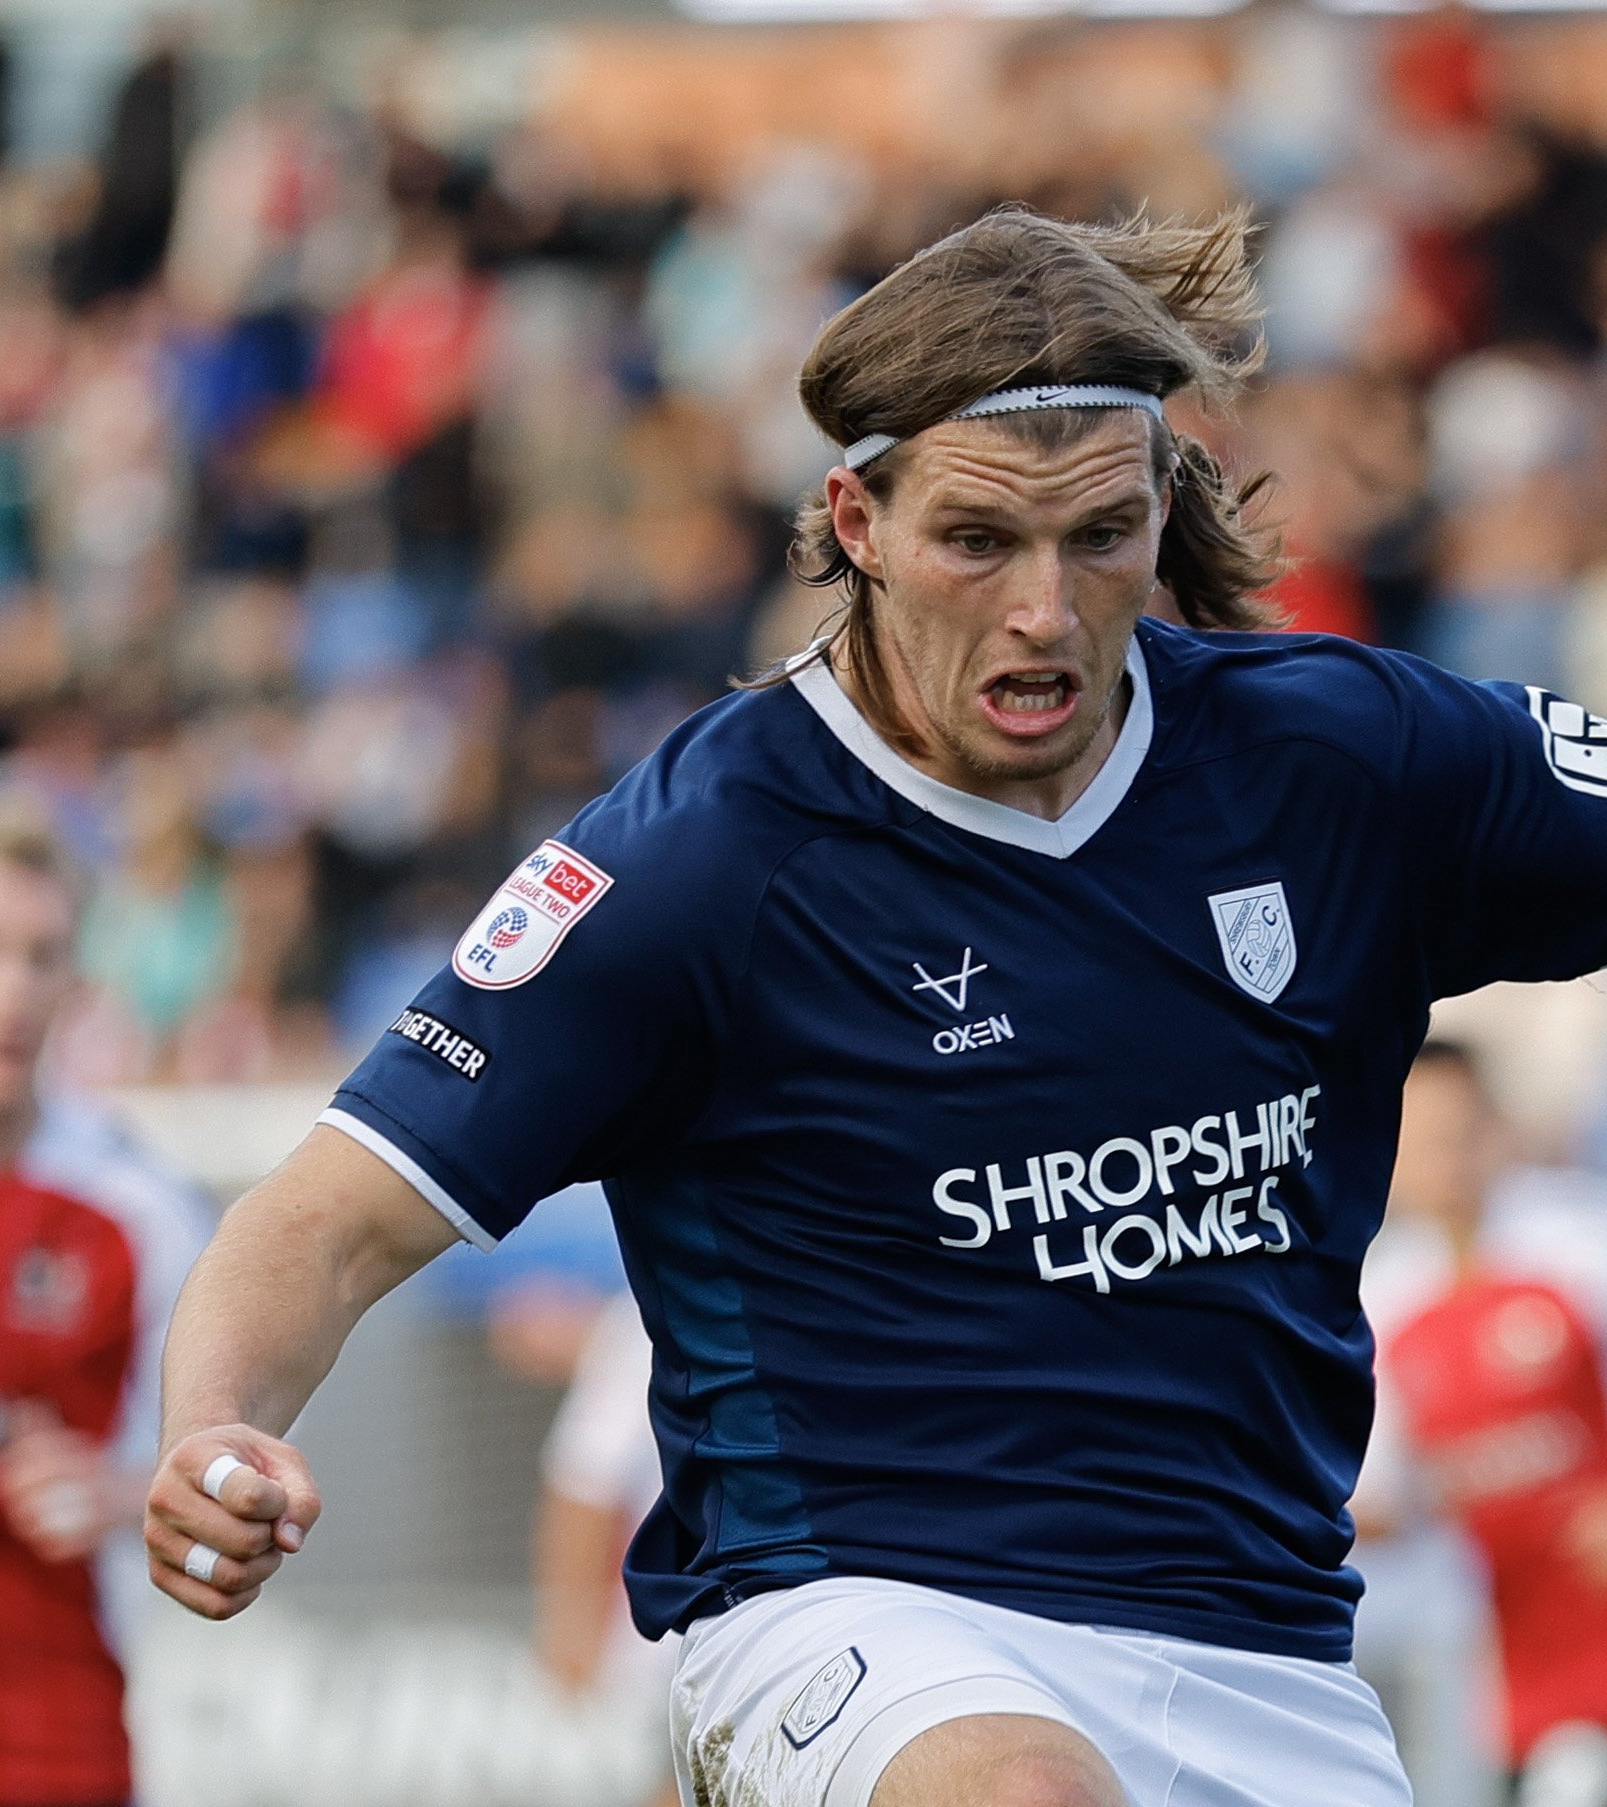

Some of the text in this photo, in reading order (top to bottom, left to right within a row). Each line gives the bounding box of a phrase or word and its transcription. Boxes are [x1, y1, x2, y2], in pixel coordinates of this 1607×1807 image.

[507, 875, 571, 919] LEAGUE TWO
[525, 852, 589, 899] sky bet
[467, 943, 499, 974] EFL
[932, 1013, 1015, 1055] OXEN
[931, 1083, 1322, 1249] SHROPSHIRE
[1032, 1176, 1291, 1294] HOMES
